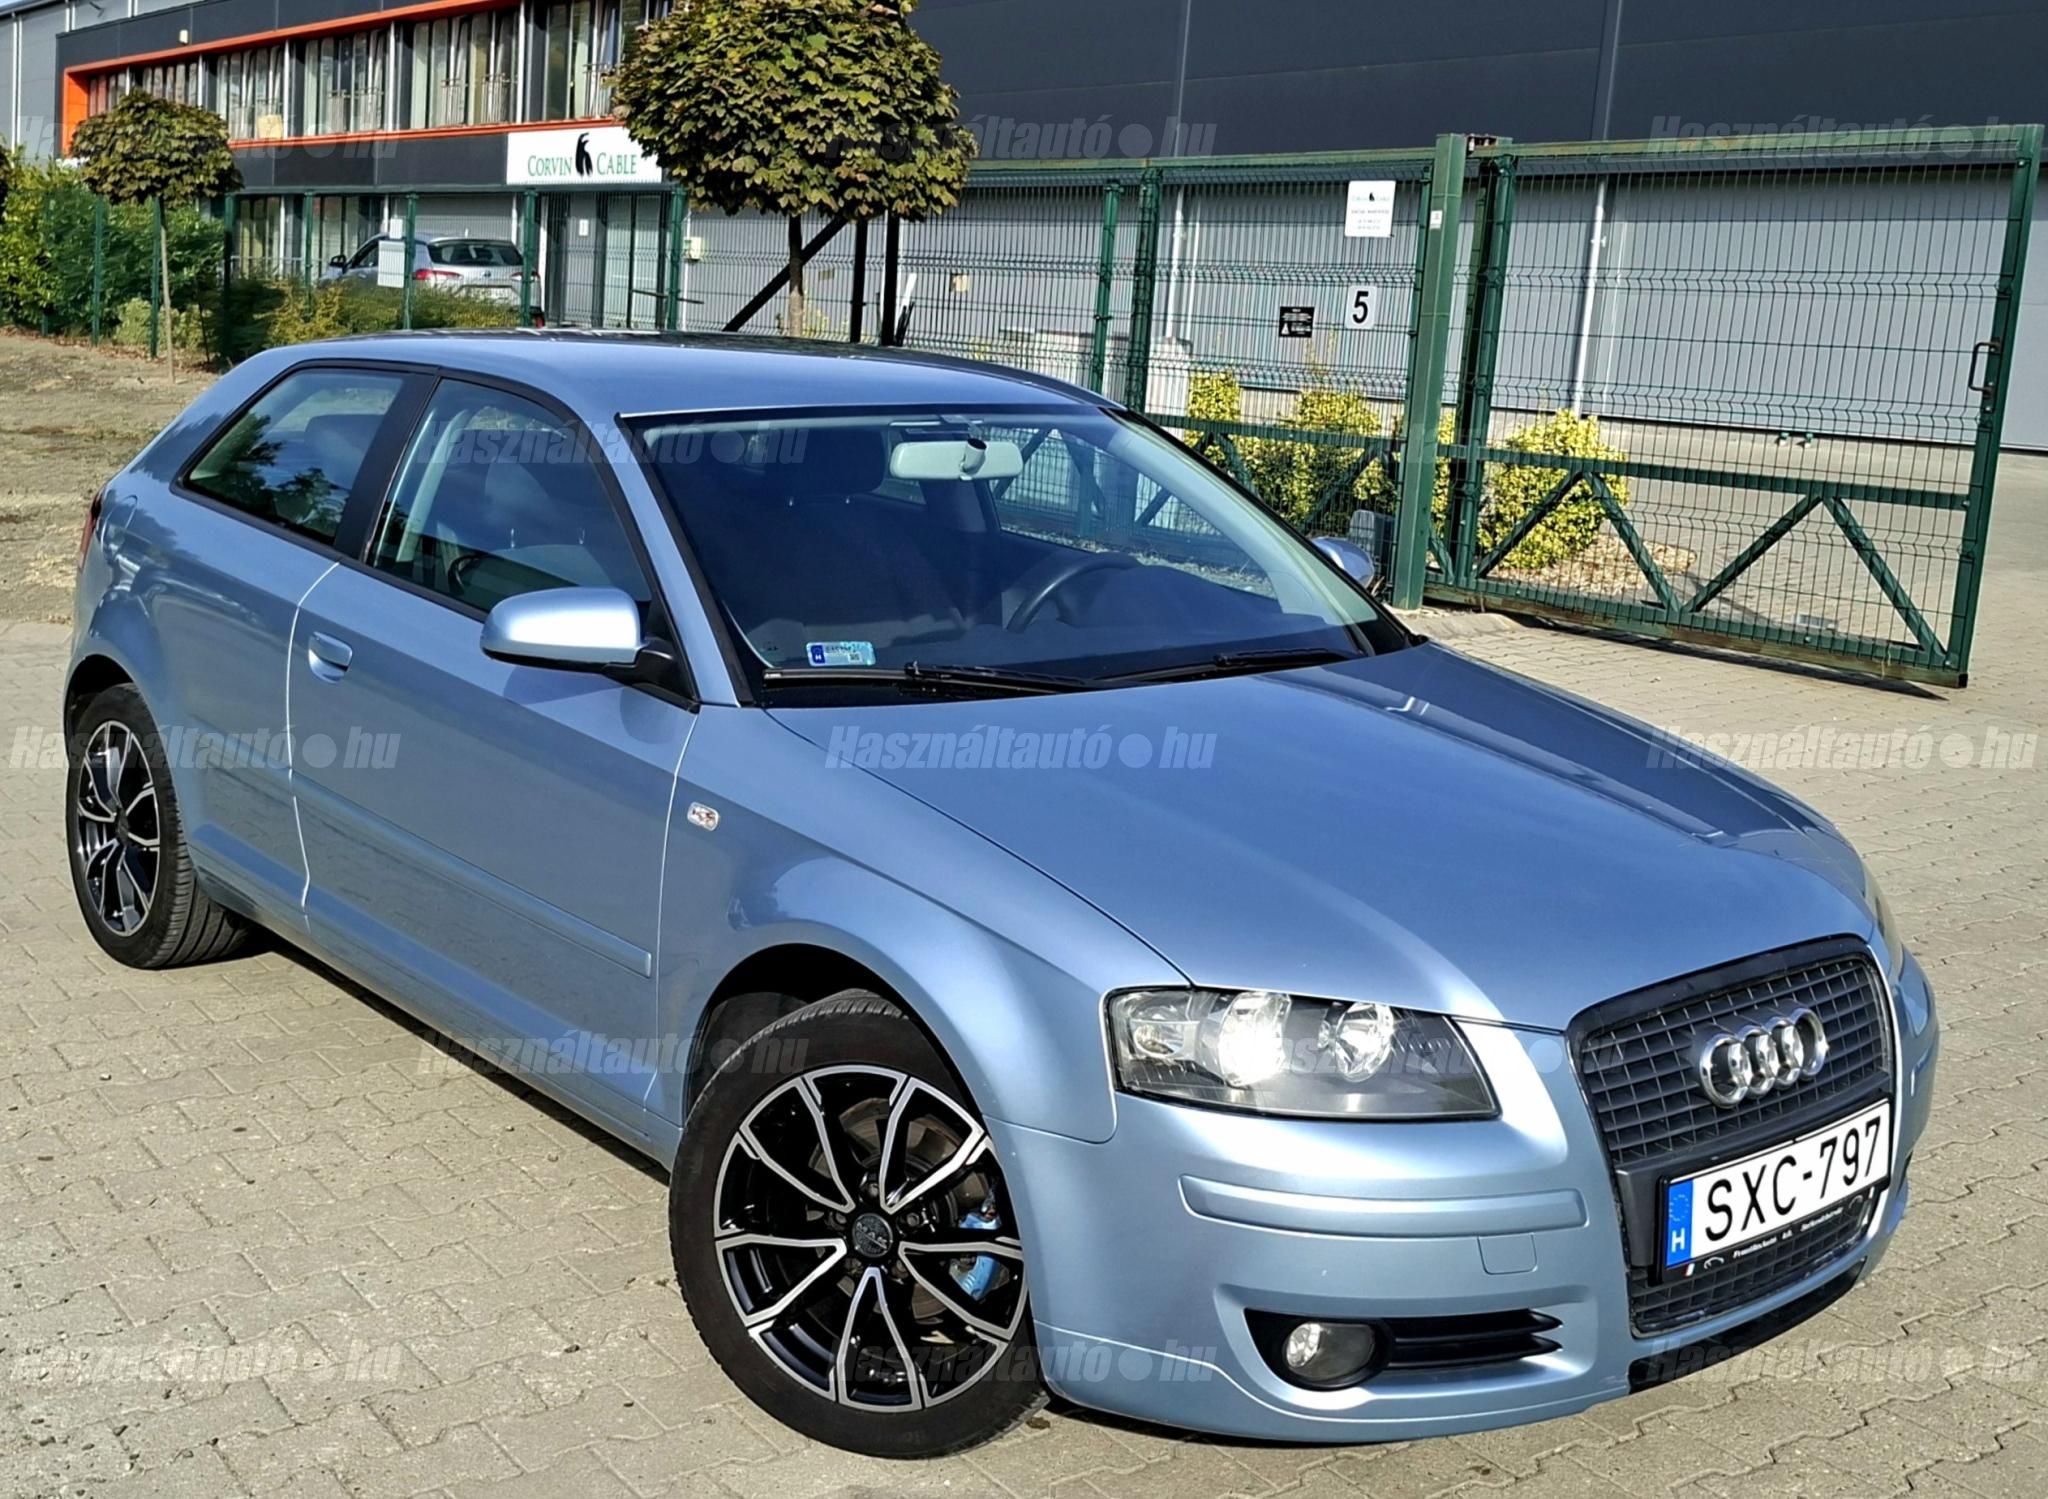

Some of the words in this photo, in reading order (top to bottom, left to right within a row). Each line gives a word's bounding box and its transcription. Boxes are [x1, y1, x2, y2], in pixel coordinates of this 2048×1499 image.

[528, 155, 573, 176] CORVIN
[597, 152, 637, 175] CABLE
[1352, 291, 1369, 324] 5
[1705, 1116, 1881, 1241] SXC-797
[1672, 1228, 1685, 1253] H
